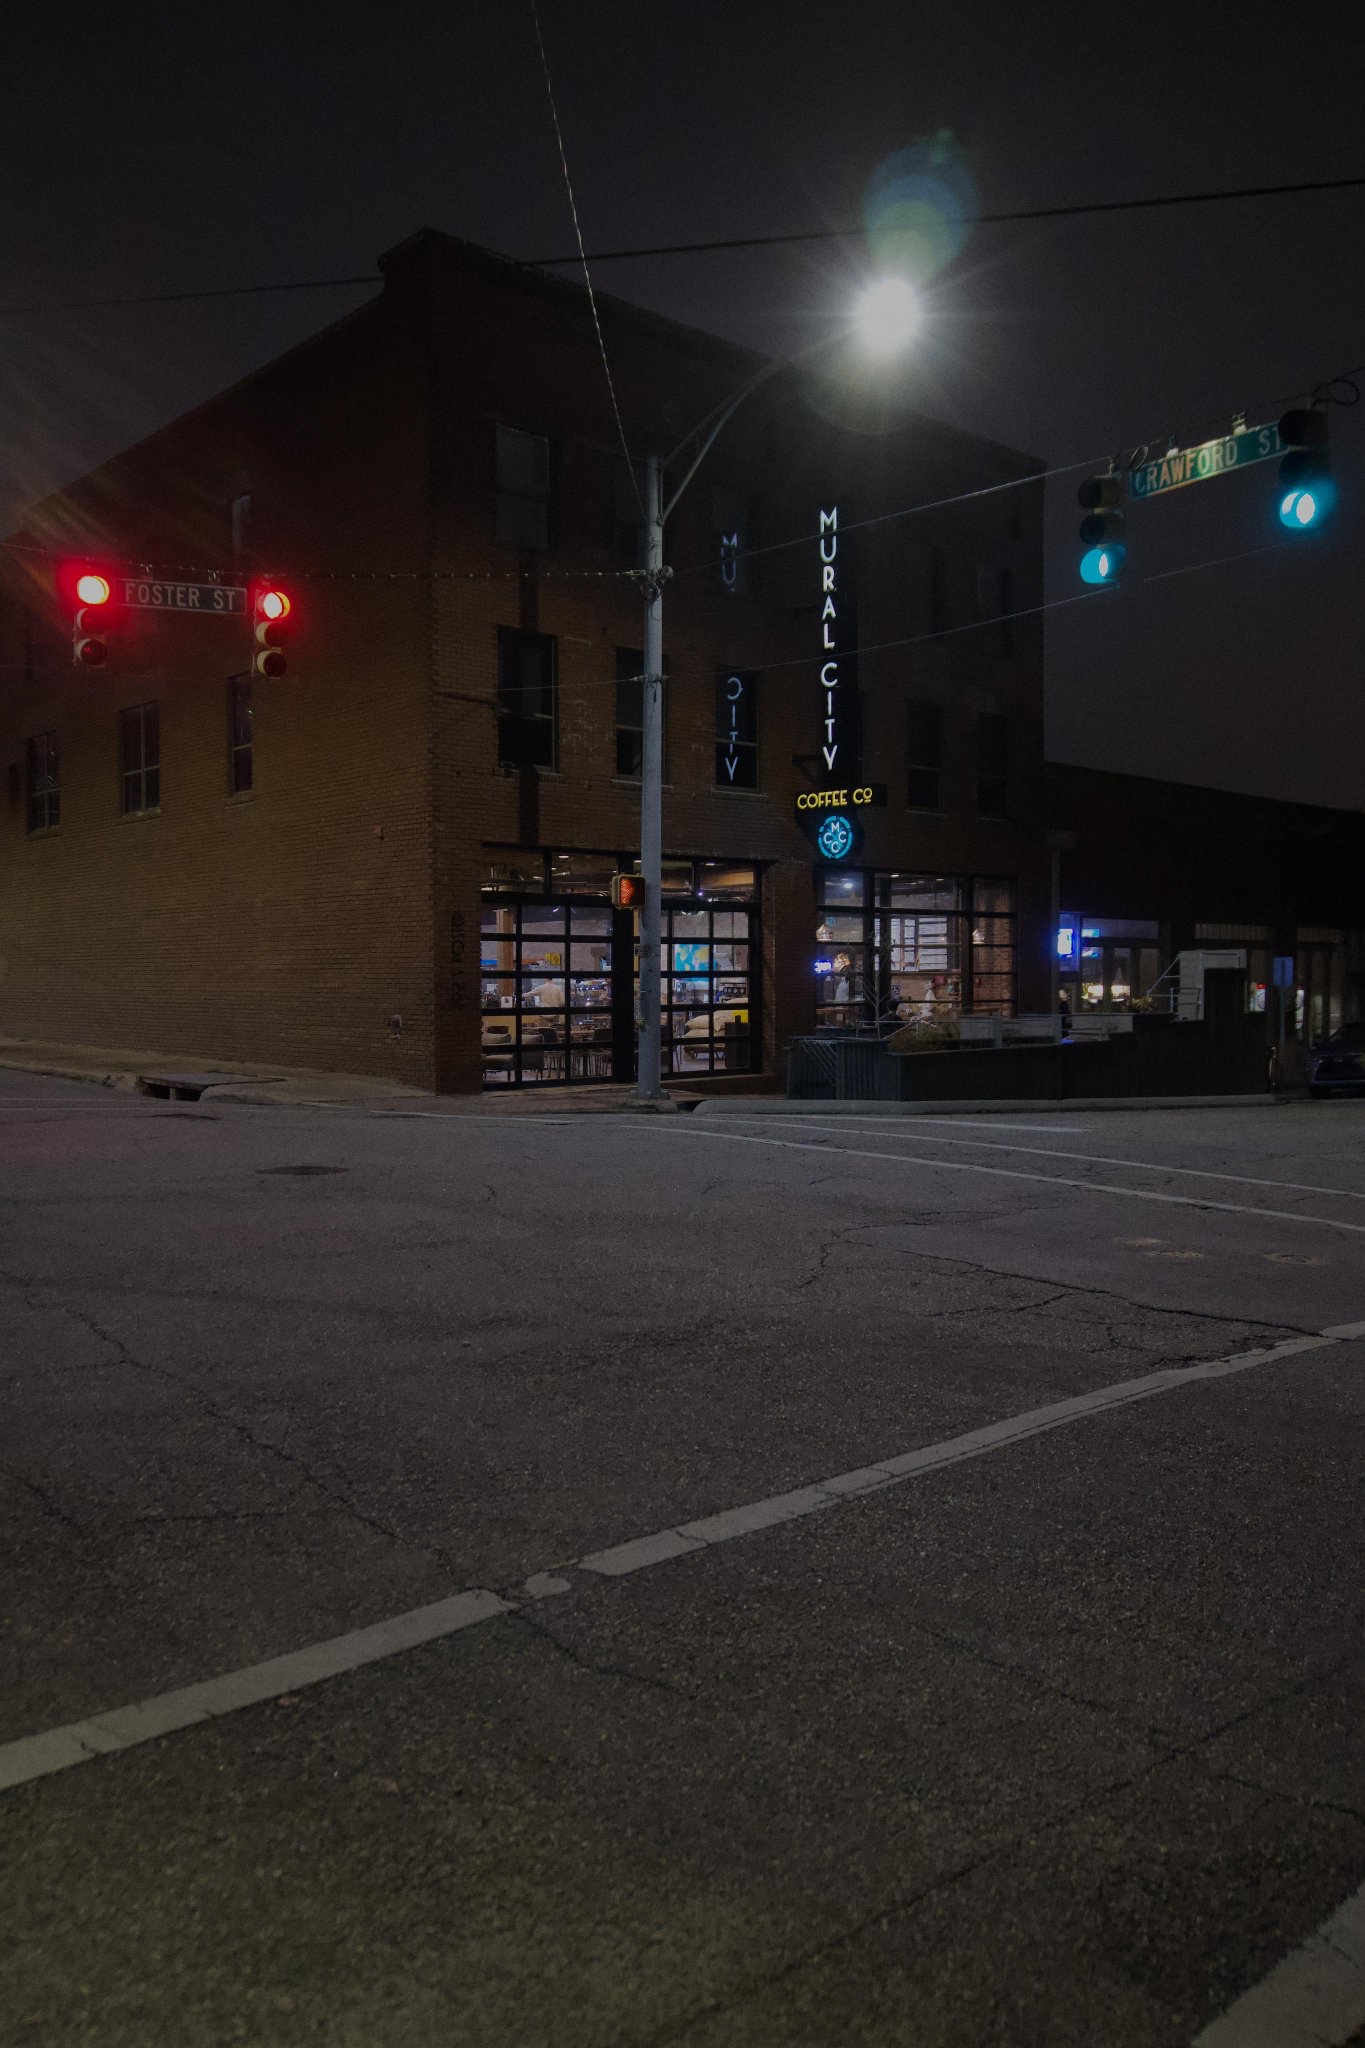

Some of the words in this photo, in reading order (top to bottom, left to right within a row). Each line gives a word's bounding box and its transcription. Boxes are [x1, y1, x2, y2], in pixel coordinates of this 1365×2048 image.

[1135, 441, 1237, 492] CRAWFORD
[1258, 425, 1282, 455] ST
[125, 583, 200, 608] FOSTER
[213, 591, 237, 611] ST
[818, 505, 838, 650] MURAL
[820, 662, 839, 771] CITY
[797, 790, 848, 810] COFFEE
